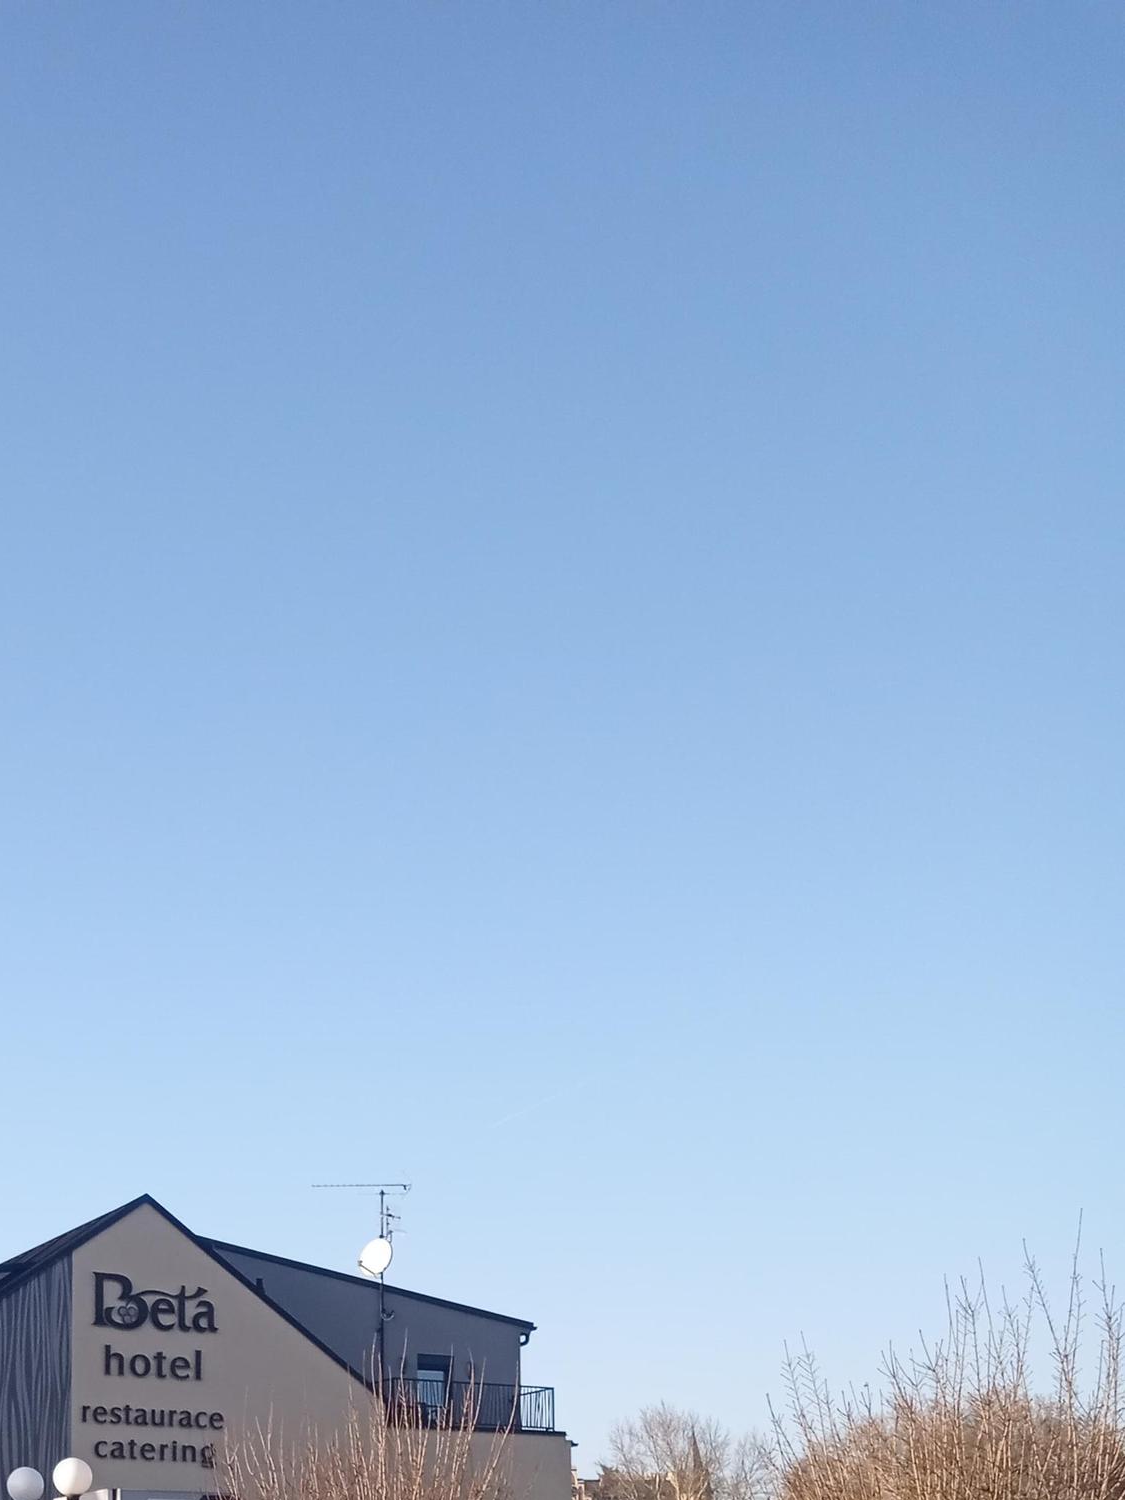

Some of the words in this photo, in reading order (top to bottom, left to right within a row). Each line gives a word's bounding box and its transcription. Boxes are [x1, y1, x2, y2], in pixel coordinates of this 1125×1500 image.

[104, 1344, 203, 1381] hotel
[81, 1404, 225, 1431] restaurace
[94, 1439, 217, 1469] catering
